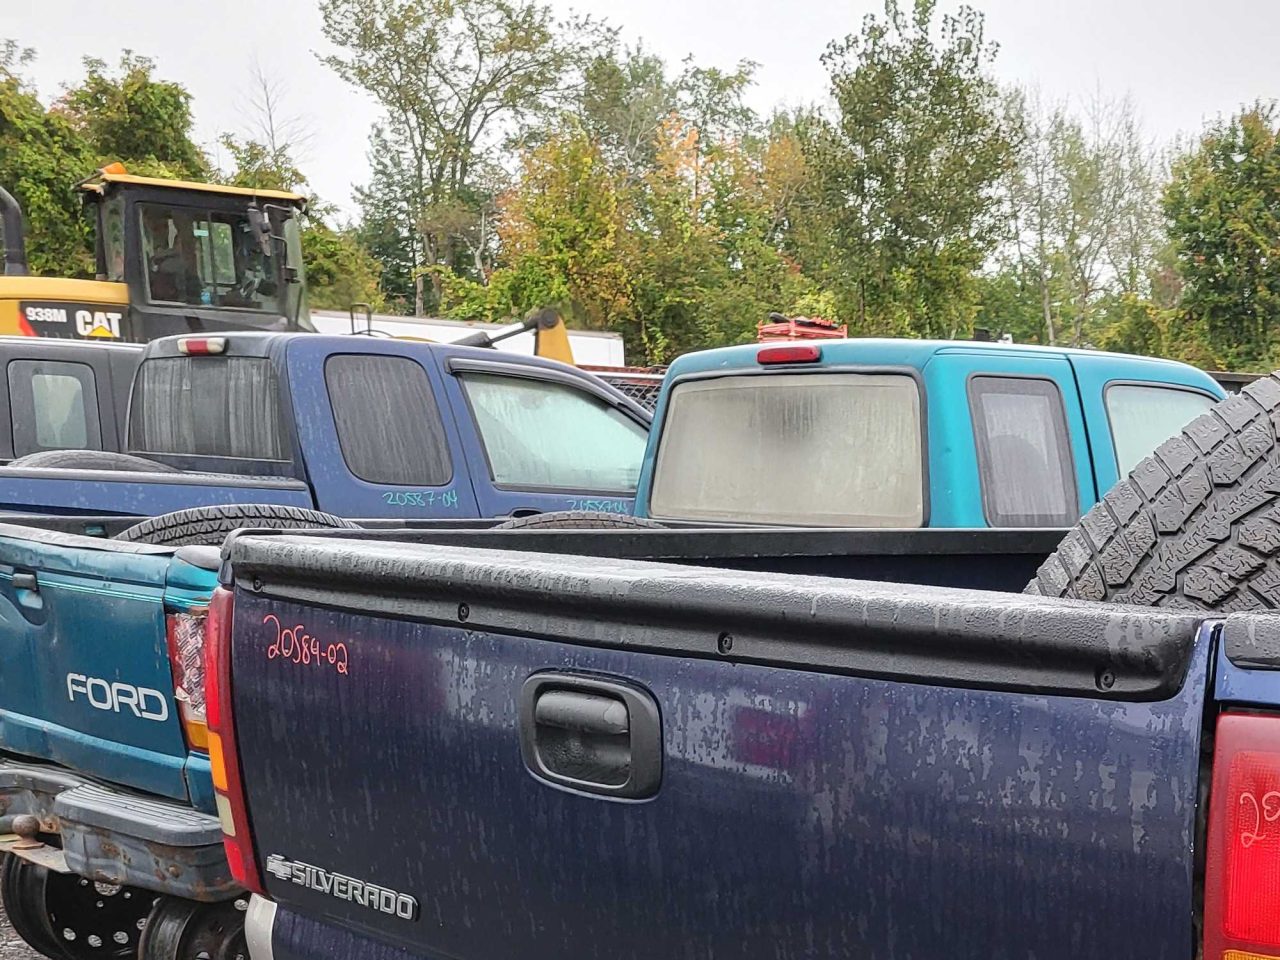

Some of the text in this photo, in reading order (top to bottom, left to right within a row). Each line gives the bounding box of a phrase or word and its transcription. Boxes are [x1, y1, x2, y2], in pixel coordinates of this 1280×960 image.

[25, 306, 67, 322] 938M
[75, 310, 122, 337] CAT
[382, 489, 458, 509] 20587-04
[263, 614, 348, 675] 20584-02
[66, 672, 169, 722] FORD
[291, 860, 419, 920] SILVERADO
